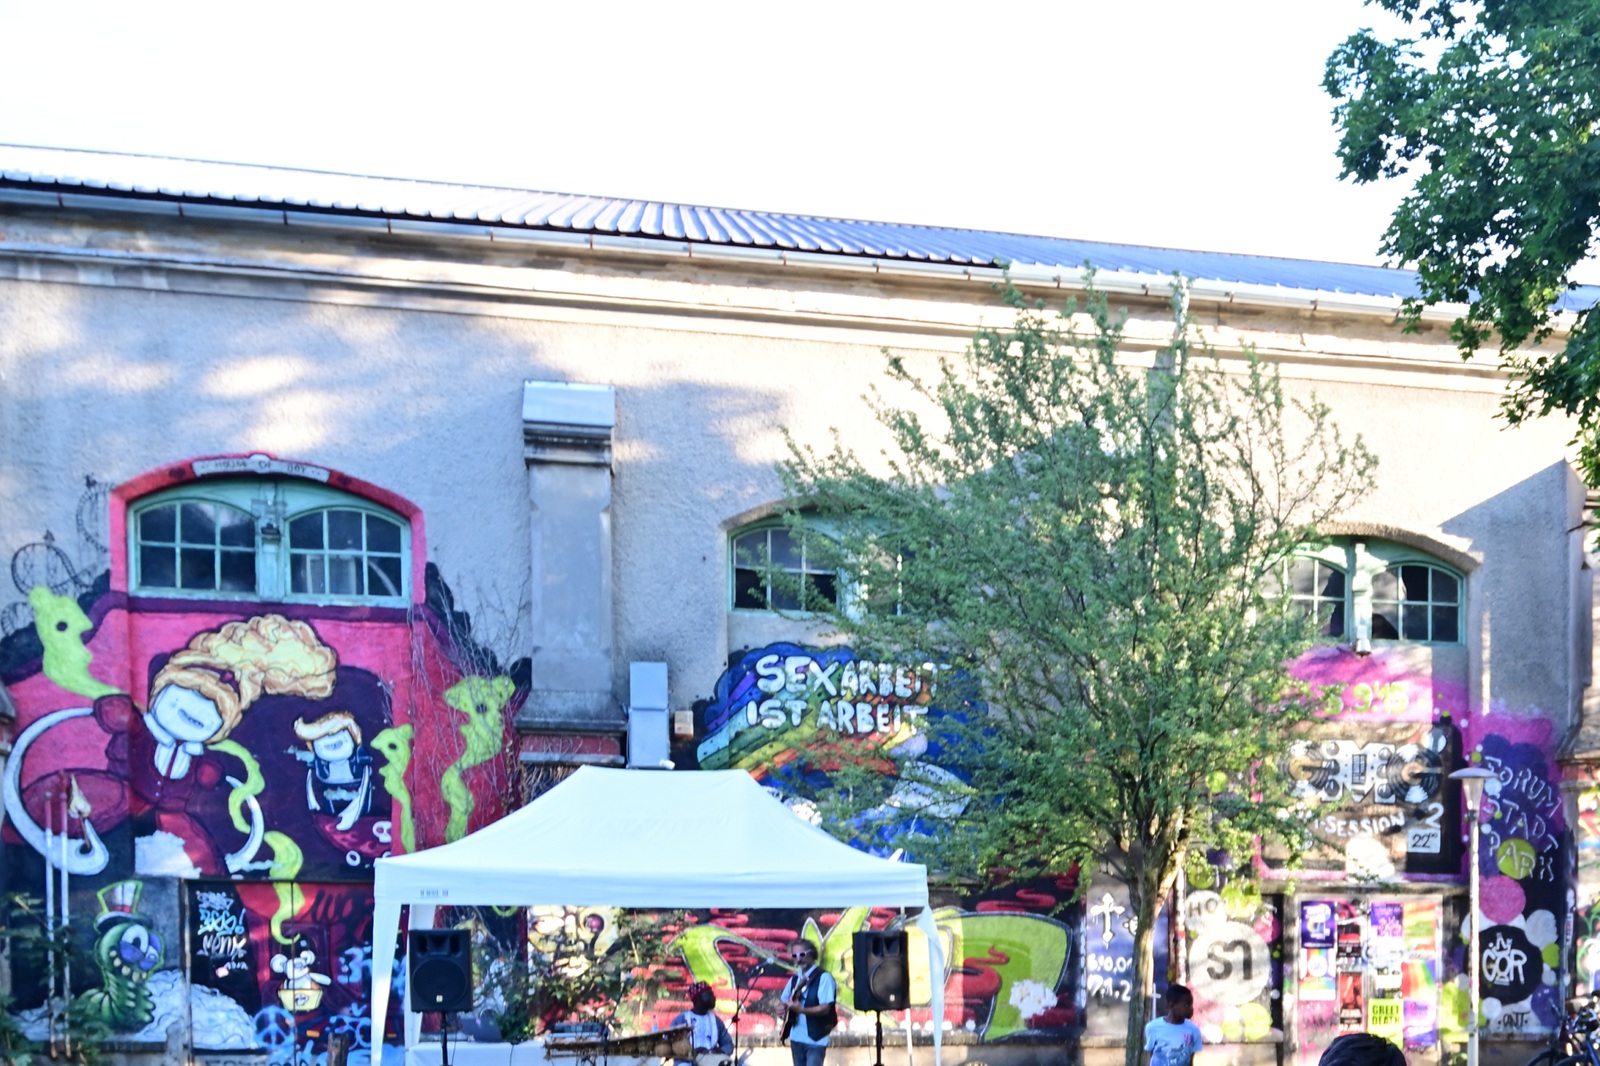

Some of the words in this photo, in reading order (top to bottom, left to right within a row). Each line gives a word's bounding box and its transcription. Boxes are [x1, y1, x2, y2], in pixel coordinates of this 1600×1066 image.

[756, 654, 952, 698] SEXARBEIT
[745, 699, 808, 729] IST
[816, 699, 929, 736] ARBEIT
[1371, 1004, 1400, 1015] GREET
[1371, 1015, 1400, 1026] DEATH
